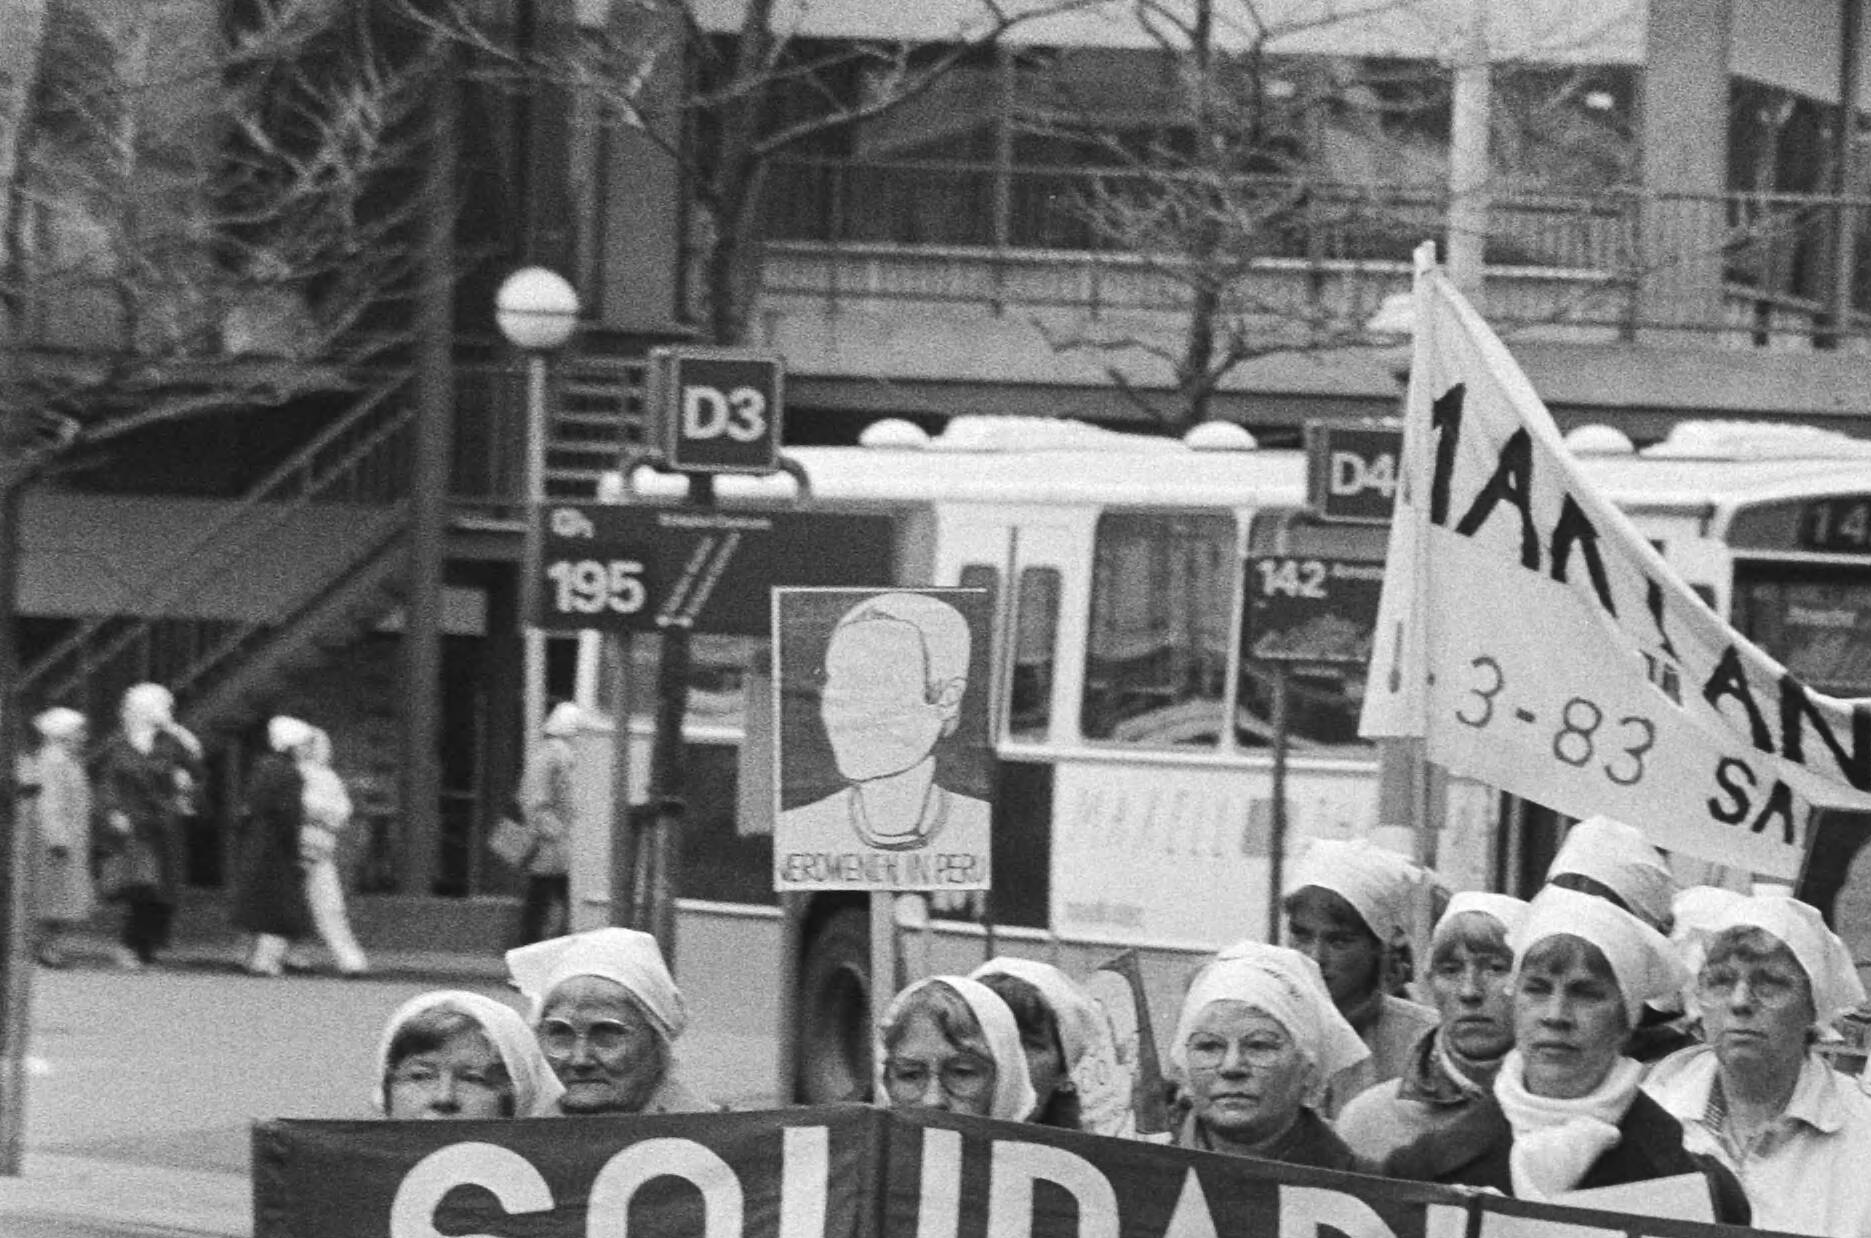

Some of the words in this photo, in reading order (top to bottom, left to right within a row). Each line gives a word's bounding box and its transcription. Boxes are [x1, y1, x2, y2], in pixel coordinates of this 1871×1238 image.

[683, 384, 767, 442] D3
[1330, 453, 1398, 498] D4
[547, 558, 647, 614] 195
[1255, 559, 1328, 599] 142
